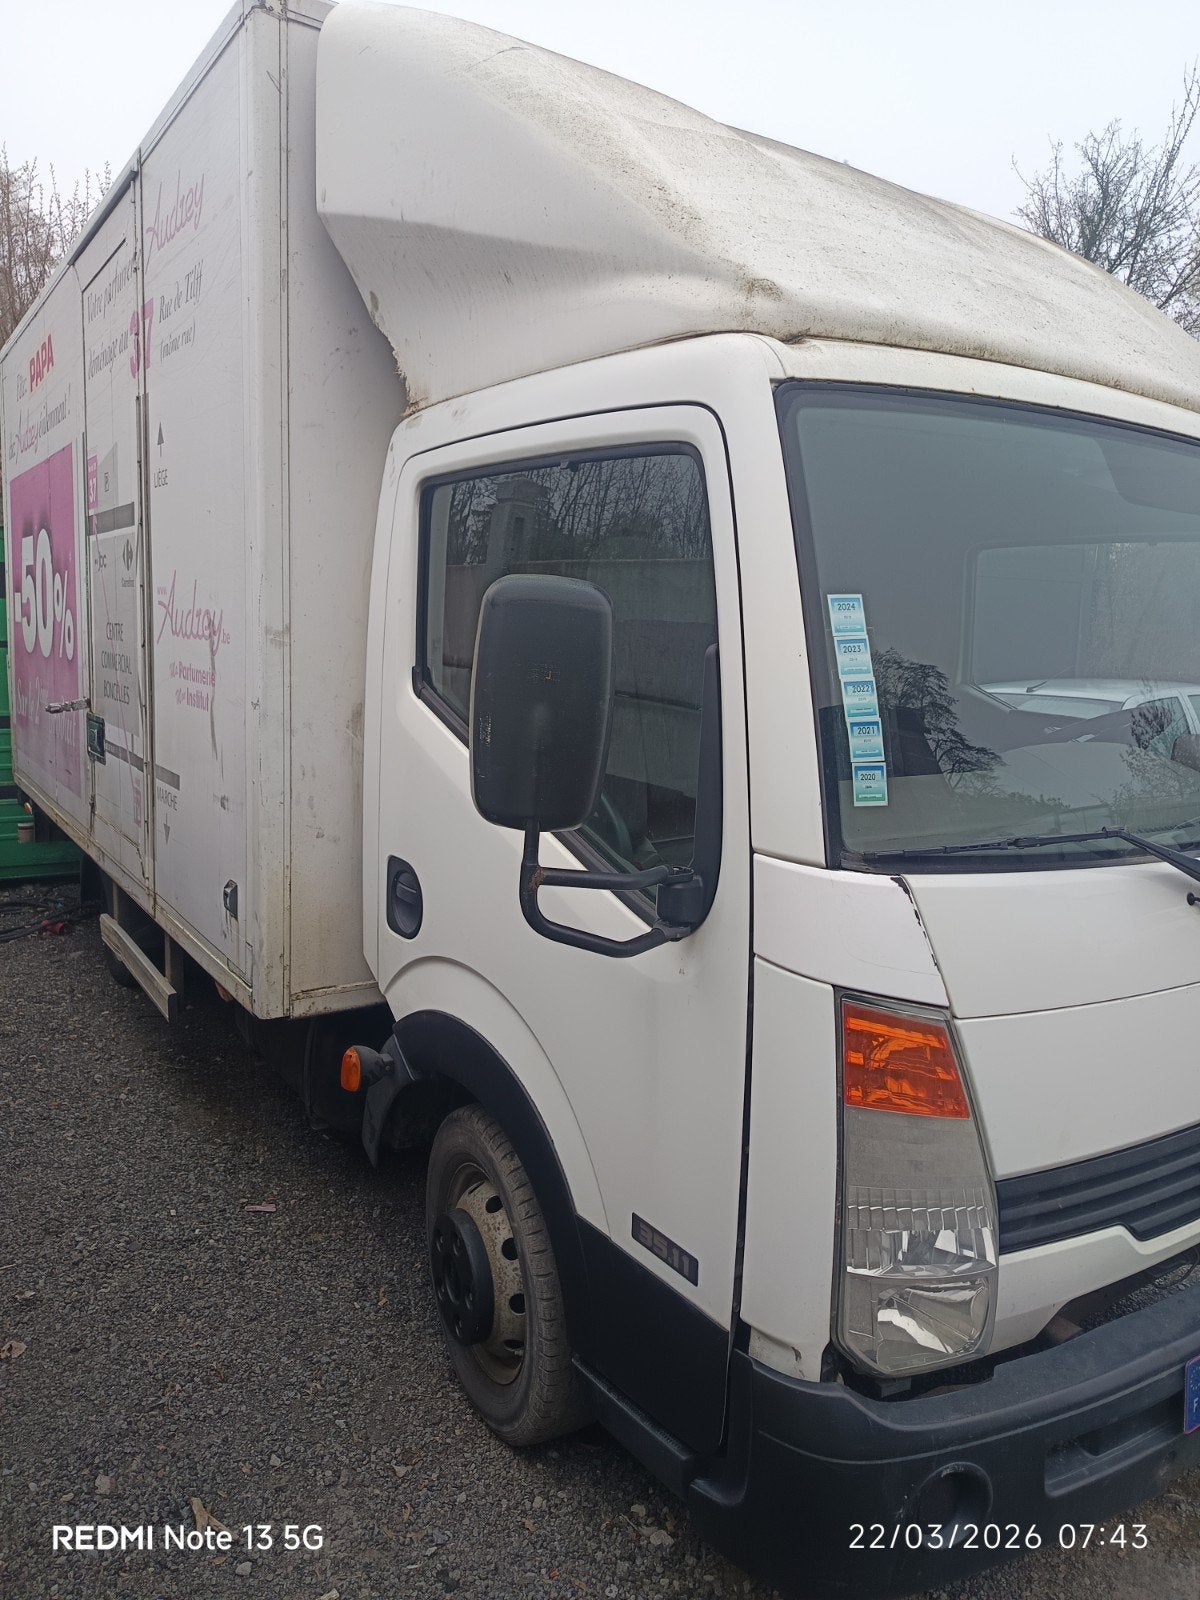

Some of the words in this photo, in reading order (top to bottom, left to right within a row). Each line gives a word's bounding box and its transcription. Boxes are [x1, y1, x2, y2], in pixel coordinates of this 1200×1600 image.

[145, 169, 204, 275] Audrey
[159, 295, 172, 324] Rue
[173, 281, 183, 312] de
[184, 259, 204, 306] Tilff
[129, 297, 154, 379] 37
[29, 333, 54, 393] PAPA
[14, 528, 75, 661] -50%
[837, 603, 856, 611] 2024
[843, 645, 862, 654] 2023
[179, 660, 216, 688] Parfumerie
[186, 686, 209, 712] Institut
[852, 685, 870, 694] 2022
[857, 727, 876, 735] 2021
[860, 773, 876, 781] 2020
[156, 786, 178, 812] MARCHE
